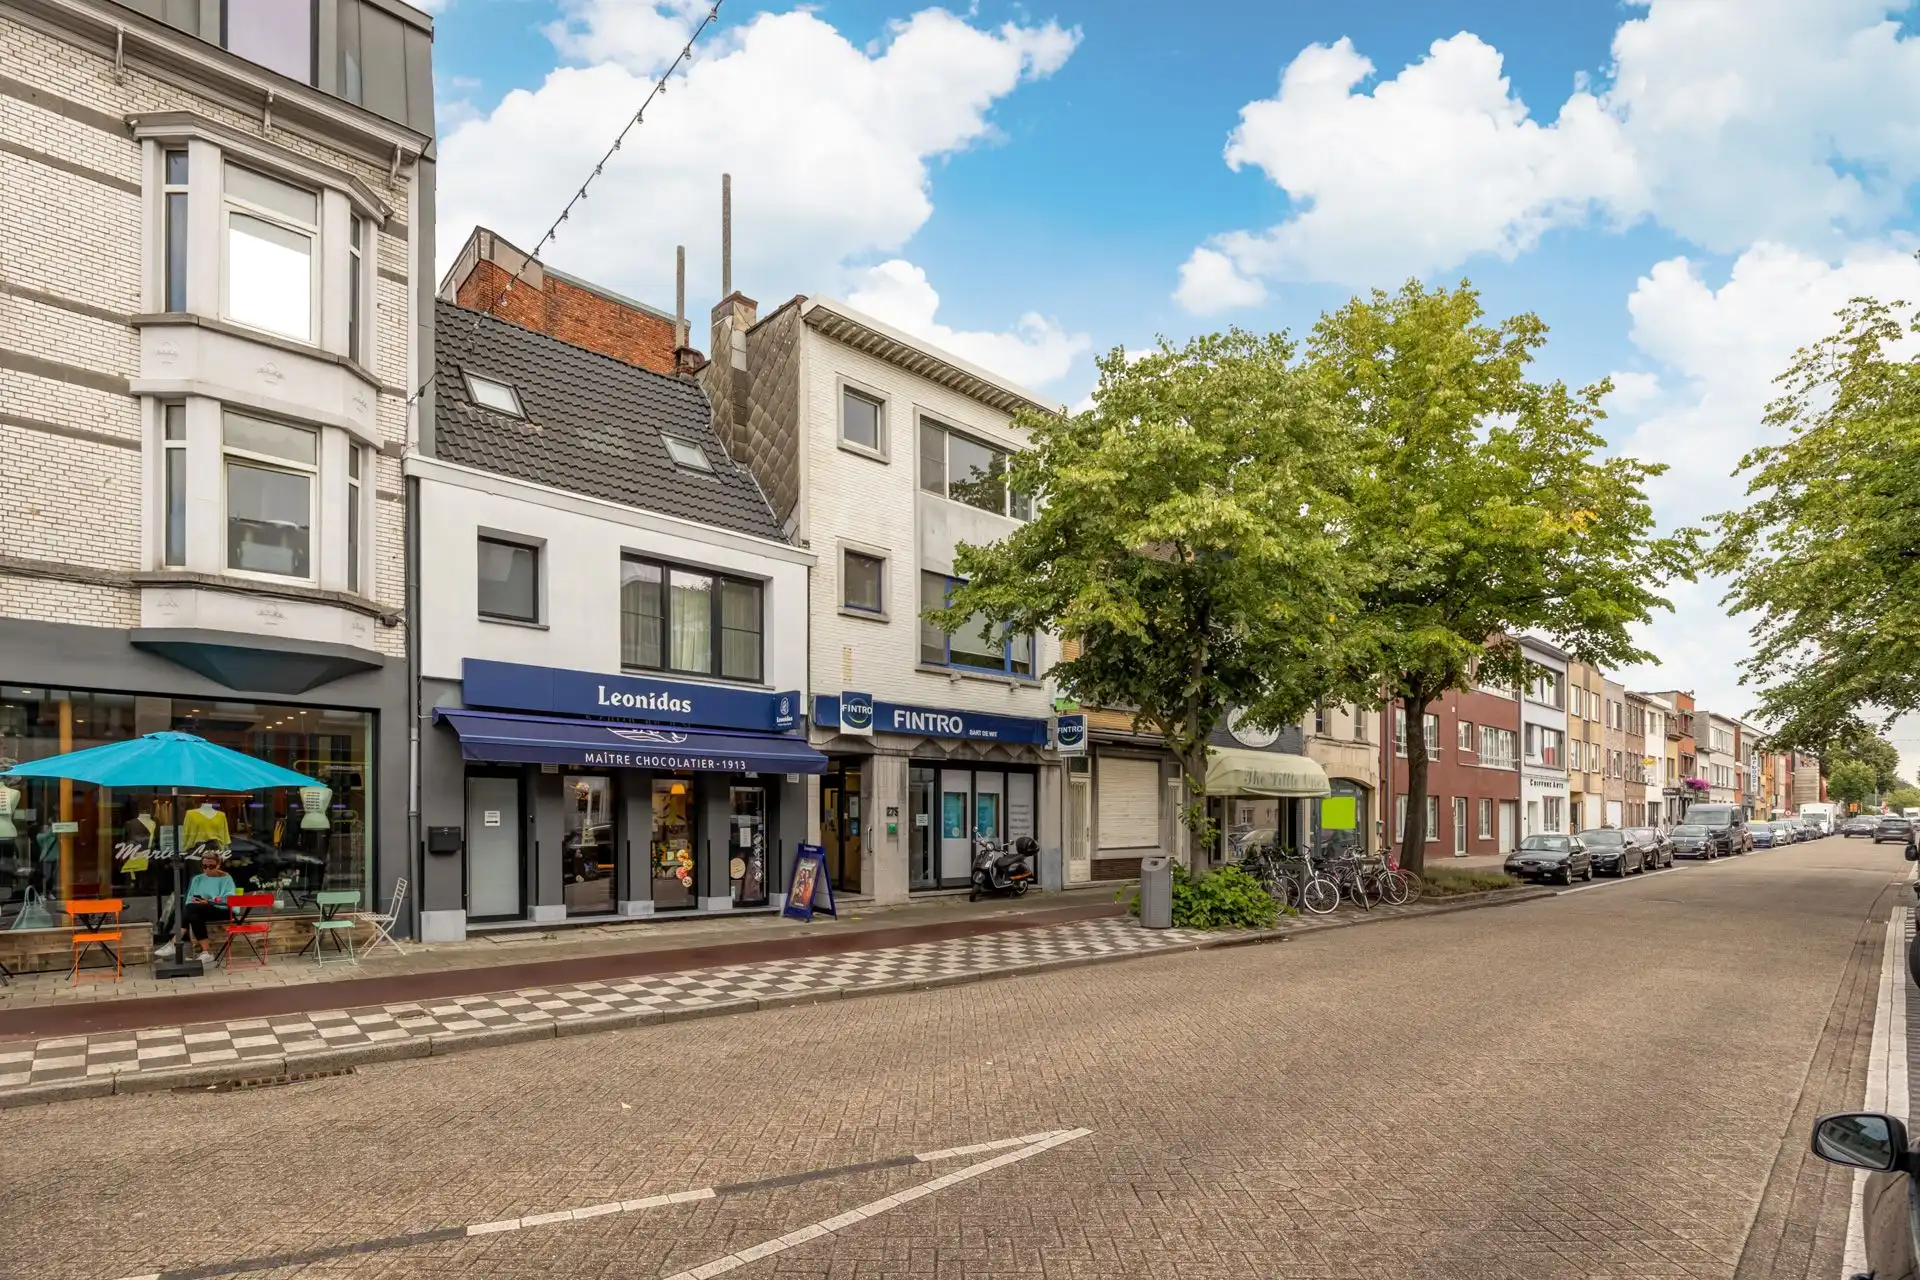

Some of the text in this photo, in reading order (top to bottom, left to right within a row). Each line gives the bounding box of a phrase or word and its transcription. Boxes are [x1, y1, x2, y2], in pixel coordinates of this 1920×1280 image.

[597, 685, 692, 713] Leonidas
[841, 703, 873, 715] FINTRO
[894, 709, 963, 734] FINTRO
[1057, 725, 1083, 734] FINTRO
[585, 751, 631, 765] MAÎTRE
[1244, 767, 1265, 786] The
